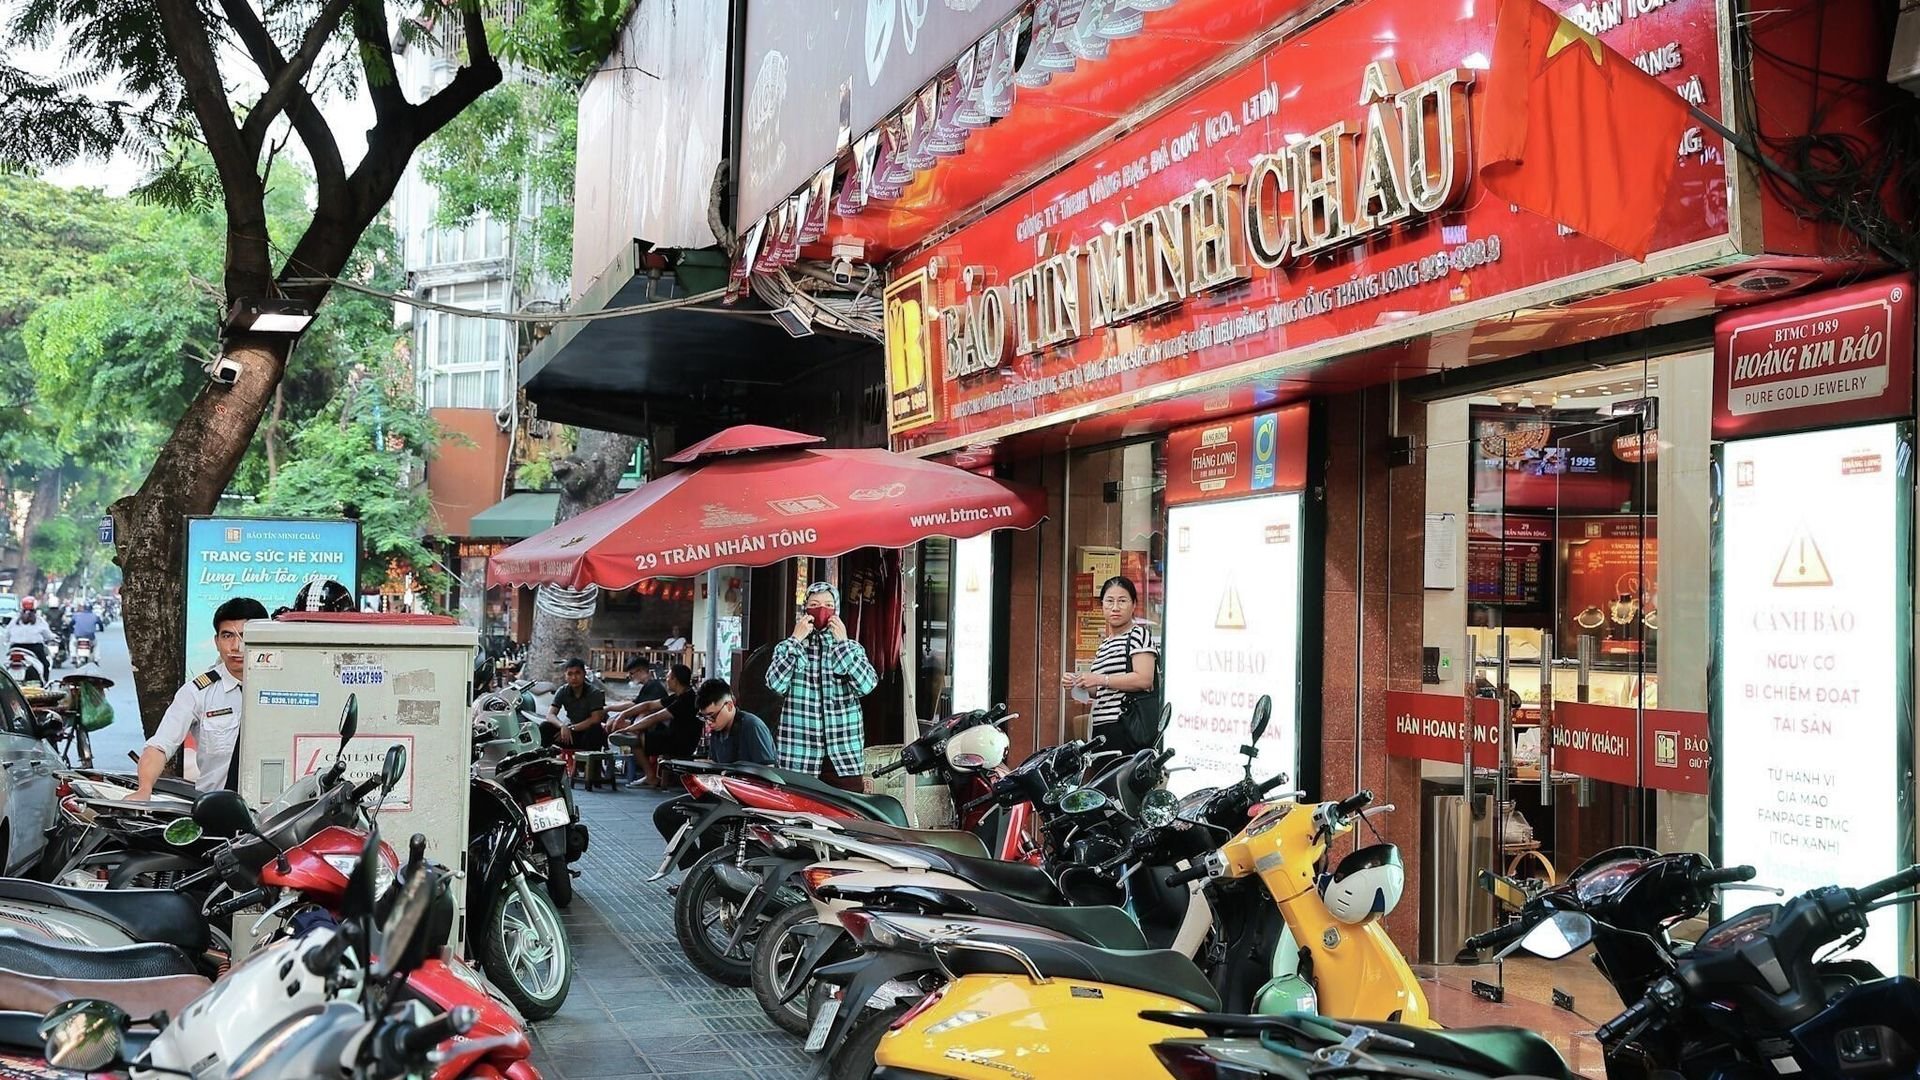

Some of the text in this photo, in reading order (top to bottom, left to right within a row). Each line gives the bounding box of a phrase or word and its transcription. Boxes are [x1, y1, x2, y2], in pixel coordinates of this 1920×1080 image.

[943, 60, 1475, 383] BẢO TÍN MINH CHÂU
[1332, 274, 1380, 310] THĂNG
[1379, 262, 1420, 296] LONG
[1775, 318, 1839, 343] BTMC 1989
[1734, 325, 1883, 381] HOÀNG KIM BẢO
[1745, 376, 1868, 406] PURE GOLD JEWELRY
[1216, 451, 1236, 466] LONG
[1570, 456, 1597, 467] 1995
[910, 503, 1012, 529] www.btmc.vn
[201, 548, 343, 563] TRANG SỨC HÈ XINH
[634, 528, 817, 571] 29 TRẦN NHÂN TÔNG
[199, 567, 242, 591] Lung
[241, 567, 272, 583] linh
[1767, 653, 1808, 669] NGUY
[342, 671, 383, 684] 0924.927.999
[1397, 713, 1419, 735] HÂN
[1423, 718, 1456, 739] HOAN
[1572, 728, 1590, 750] QUÝ
[1591, 730, 1624, 757] KHÁCH
[1684, 734, 1708, 752] BẢO
[1689, 757, 1704, 769] GIỮ
[1758, 808, 1850, 833] FANPAGE BTMC
